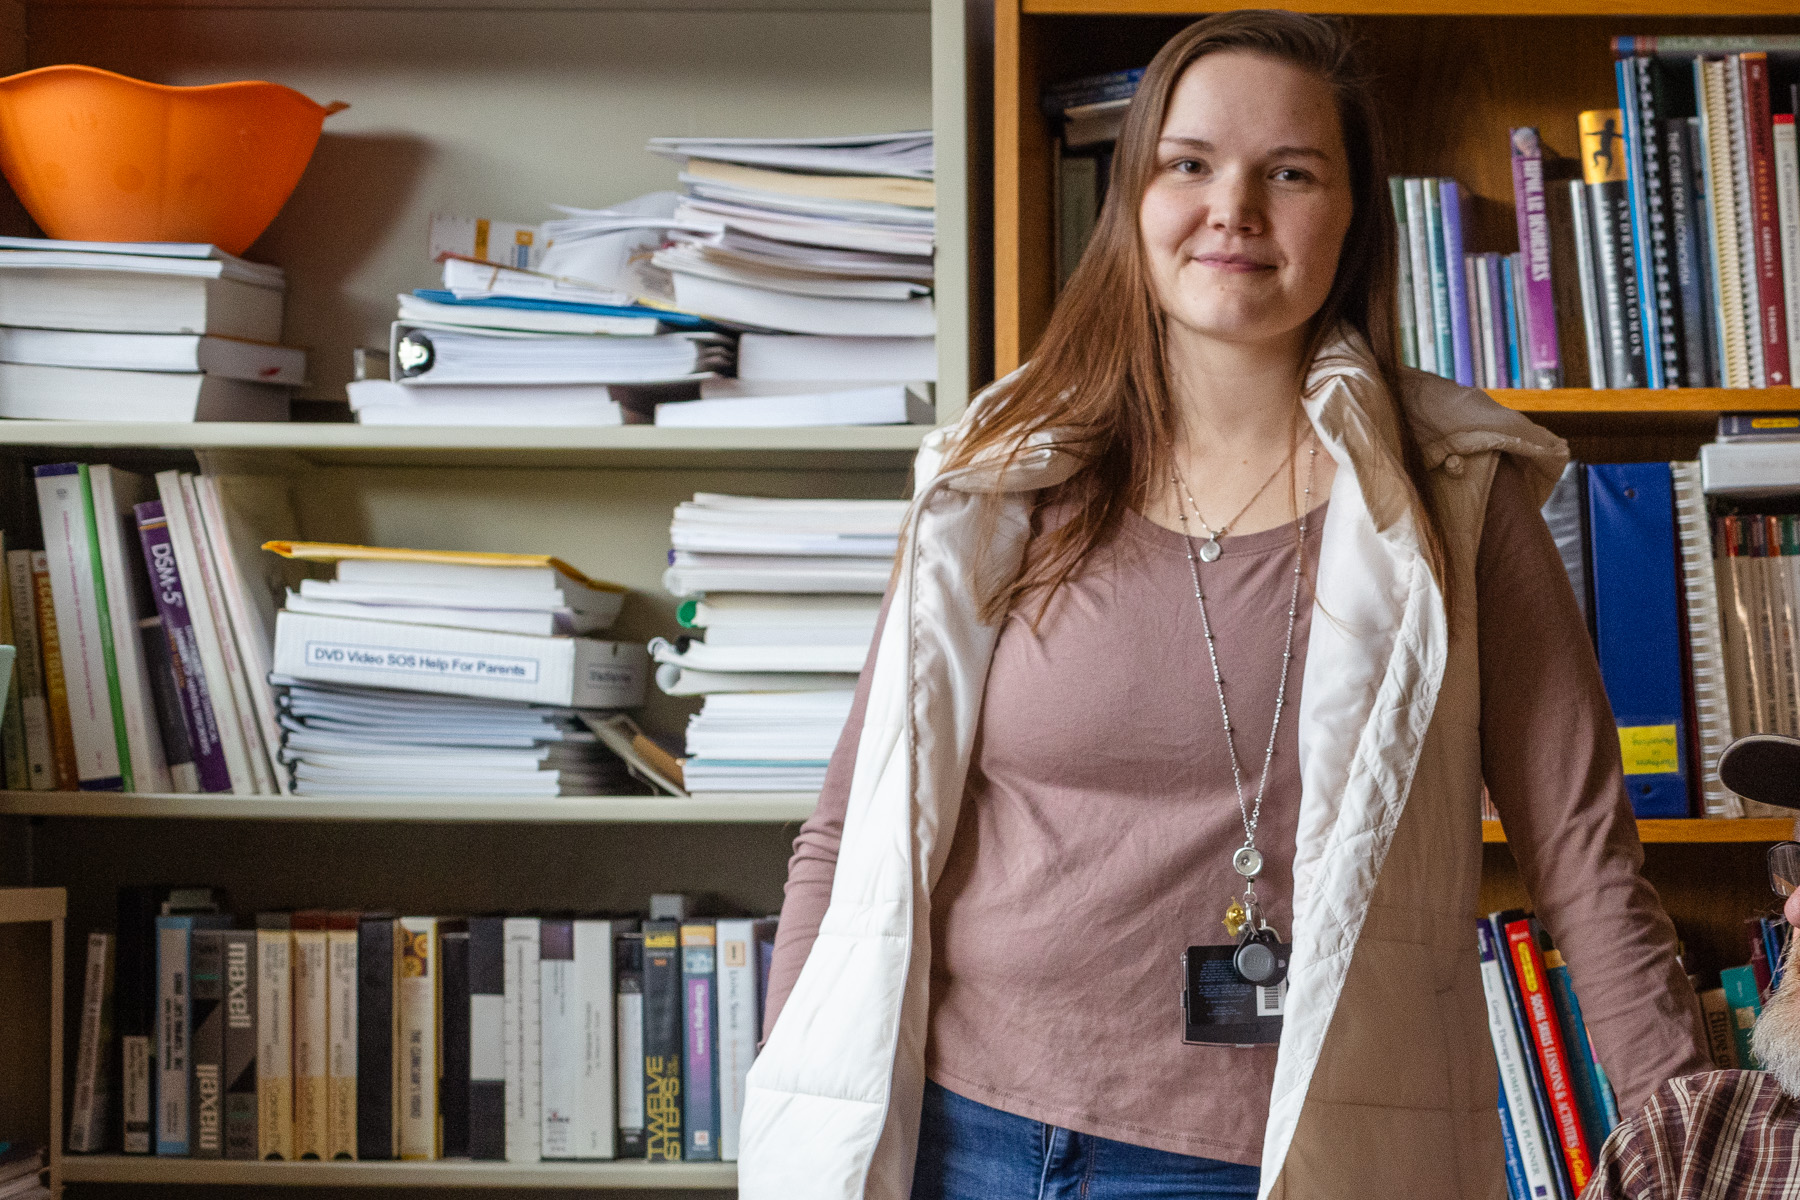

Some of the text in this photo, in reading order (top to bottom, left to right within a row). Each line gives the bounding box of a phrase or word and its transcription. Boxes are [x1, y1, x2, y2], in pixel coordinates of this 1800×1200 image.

[1667, 131, 1691, 285] THE CURE FOR ALCOHOLISM
[1618, 199, 1642, 357] ANDREW SOLOMON
[37, 577, 65, 697] ECKHART TOLLE
[314, 647, 527, 678] DVD Video SOS Help For Parents
[227, 943, 252, 1029] maxell
[693, 984, 705, 1055] Changing Lives
[196, 1064, 220, 1149] maxell
[646, 1056, 663, 1162] TWELVE
[663, 1077, 679, 1161] STEPS
[1506, 1063, 1529, 1127] HOMEWORK
[1521, 1129, 1542, 1175] PLANNER
